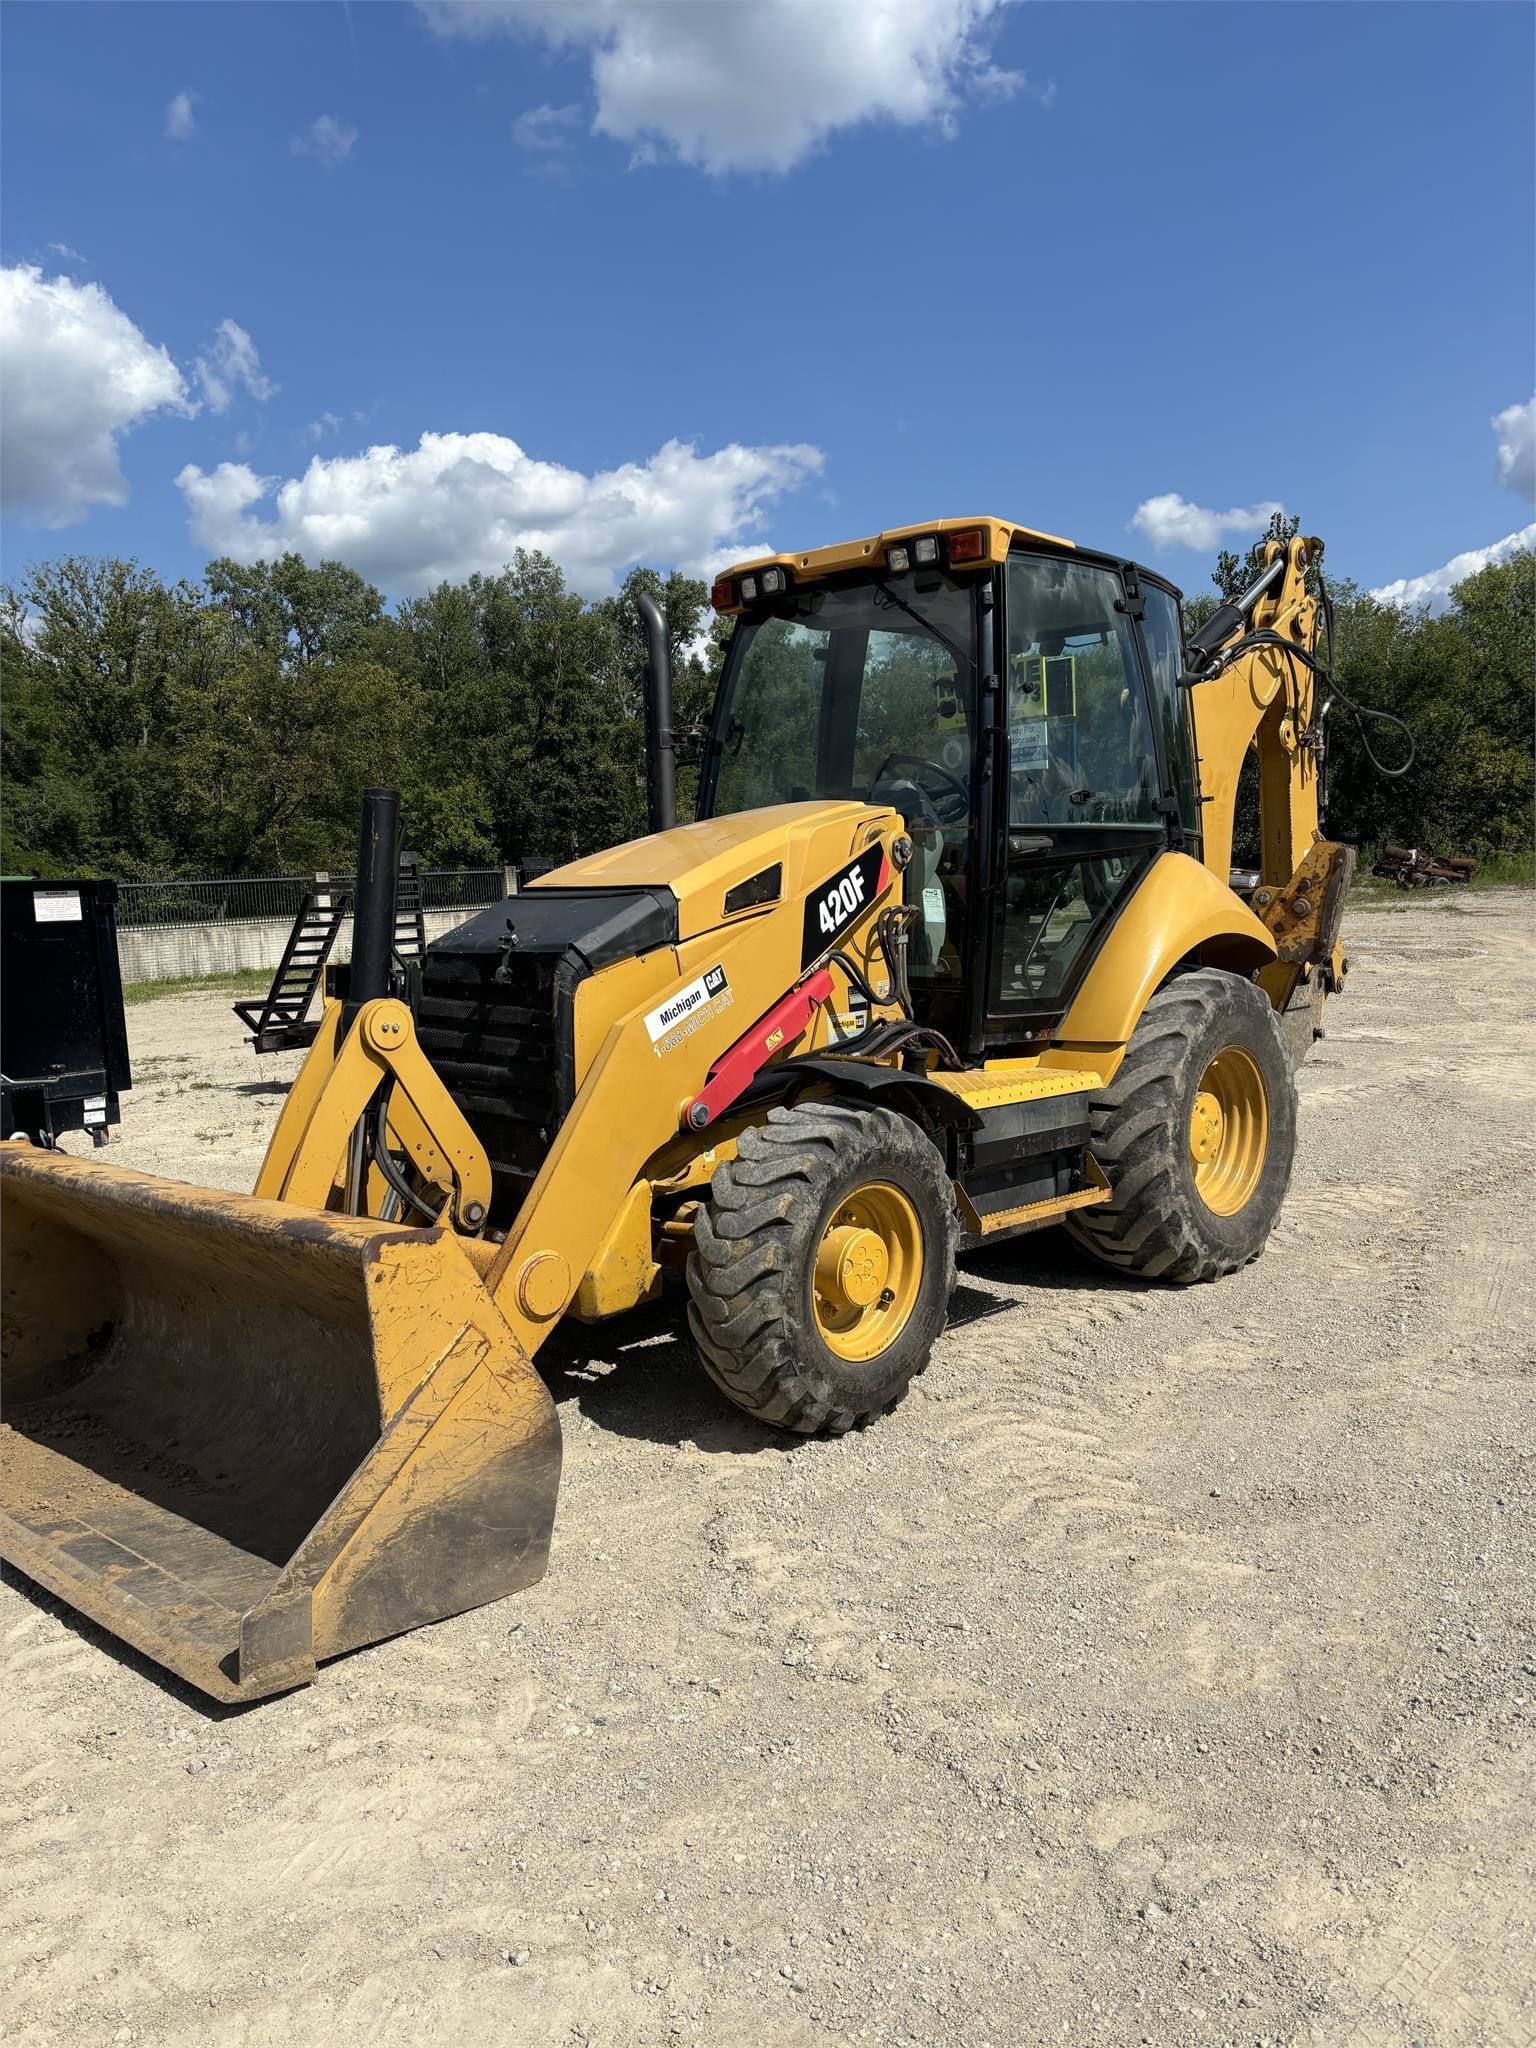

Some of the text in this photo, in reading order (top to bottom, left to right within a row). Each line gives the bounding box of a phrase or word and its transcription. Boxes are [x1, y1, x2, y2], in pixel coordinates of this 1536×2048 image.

[819, 864, 865, 934] 420F
[659, 968, 724, 1026] Michigan CAT
